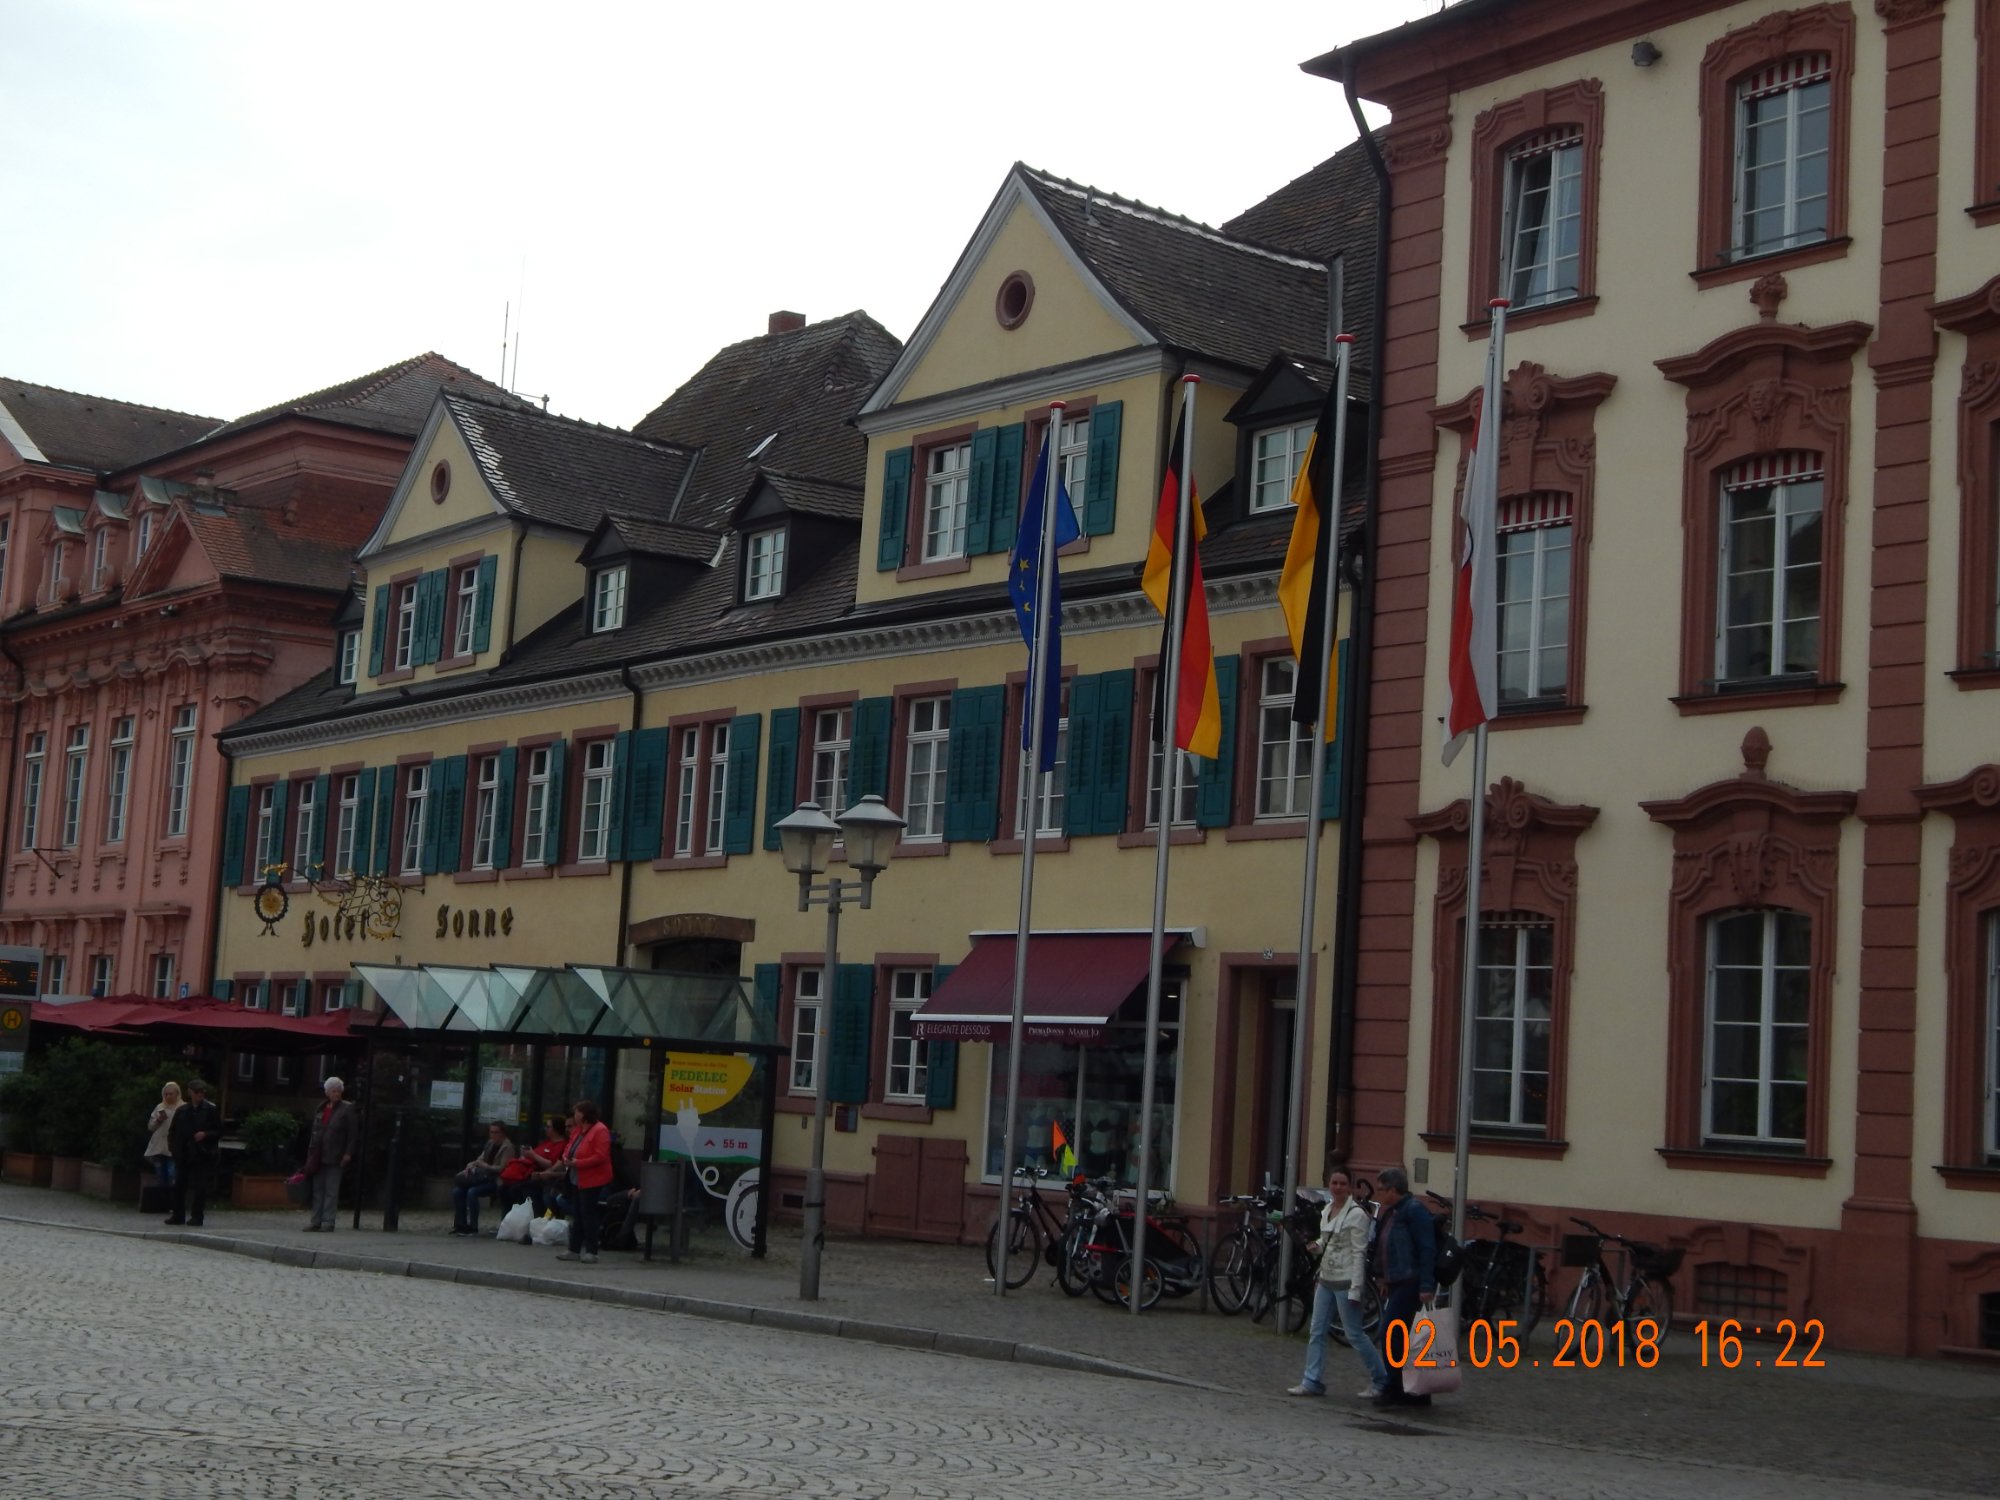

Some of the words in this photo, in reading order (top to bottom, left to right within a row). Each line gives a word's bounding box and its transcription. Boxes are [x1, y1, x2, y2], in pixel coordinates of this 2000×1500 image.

[436, 903, 514, 939] Sonne
[926, 1023, 959, 1035] ELEGANTE
[960, 1024, 991, 1036] DESSOUS
[671, 1069, 728, 1084] PEDELEC
[723, 1138, 735, 1149] 55
[738, 1141, 748, 1149] m
